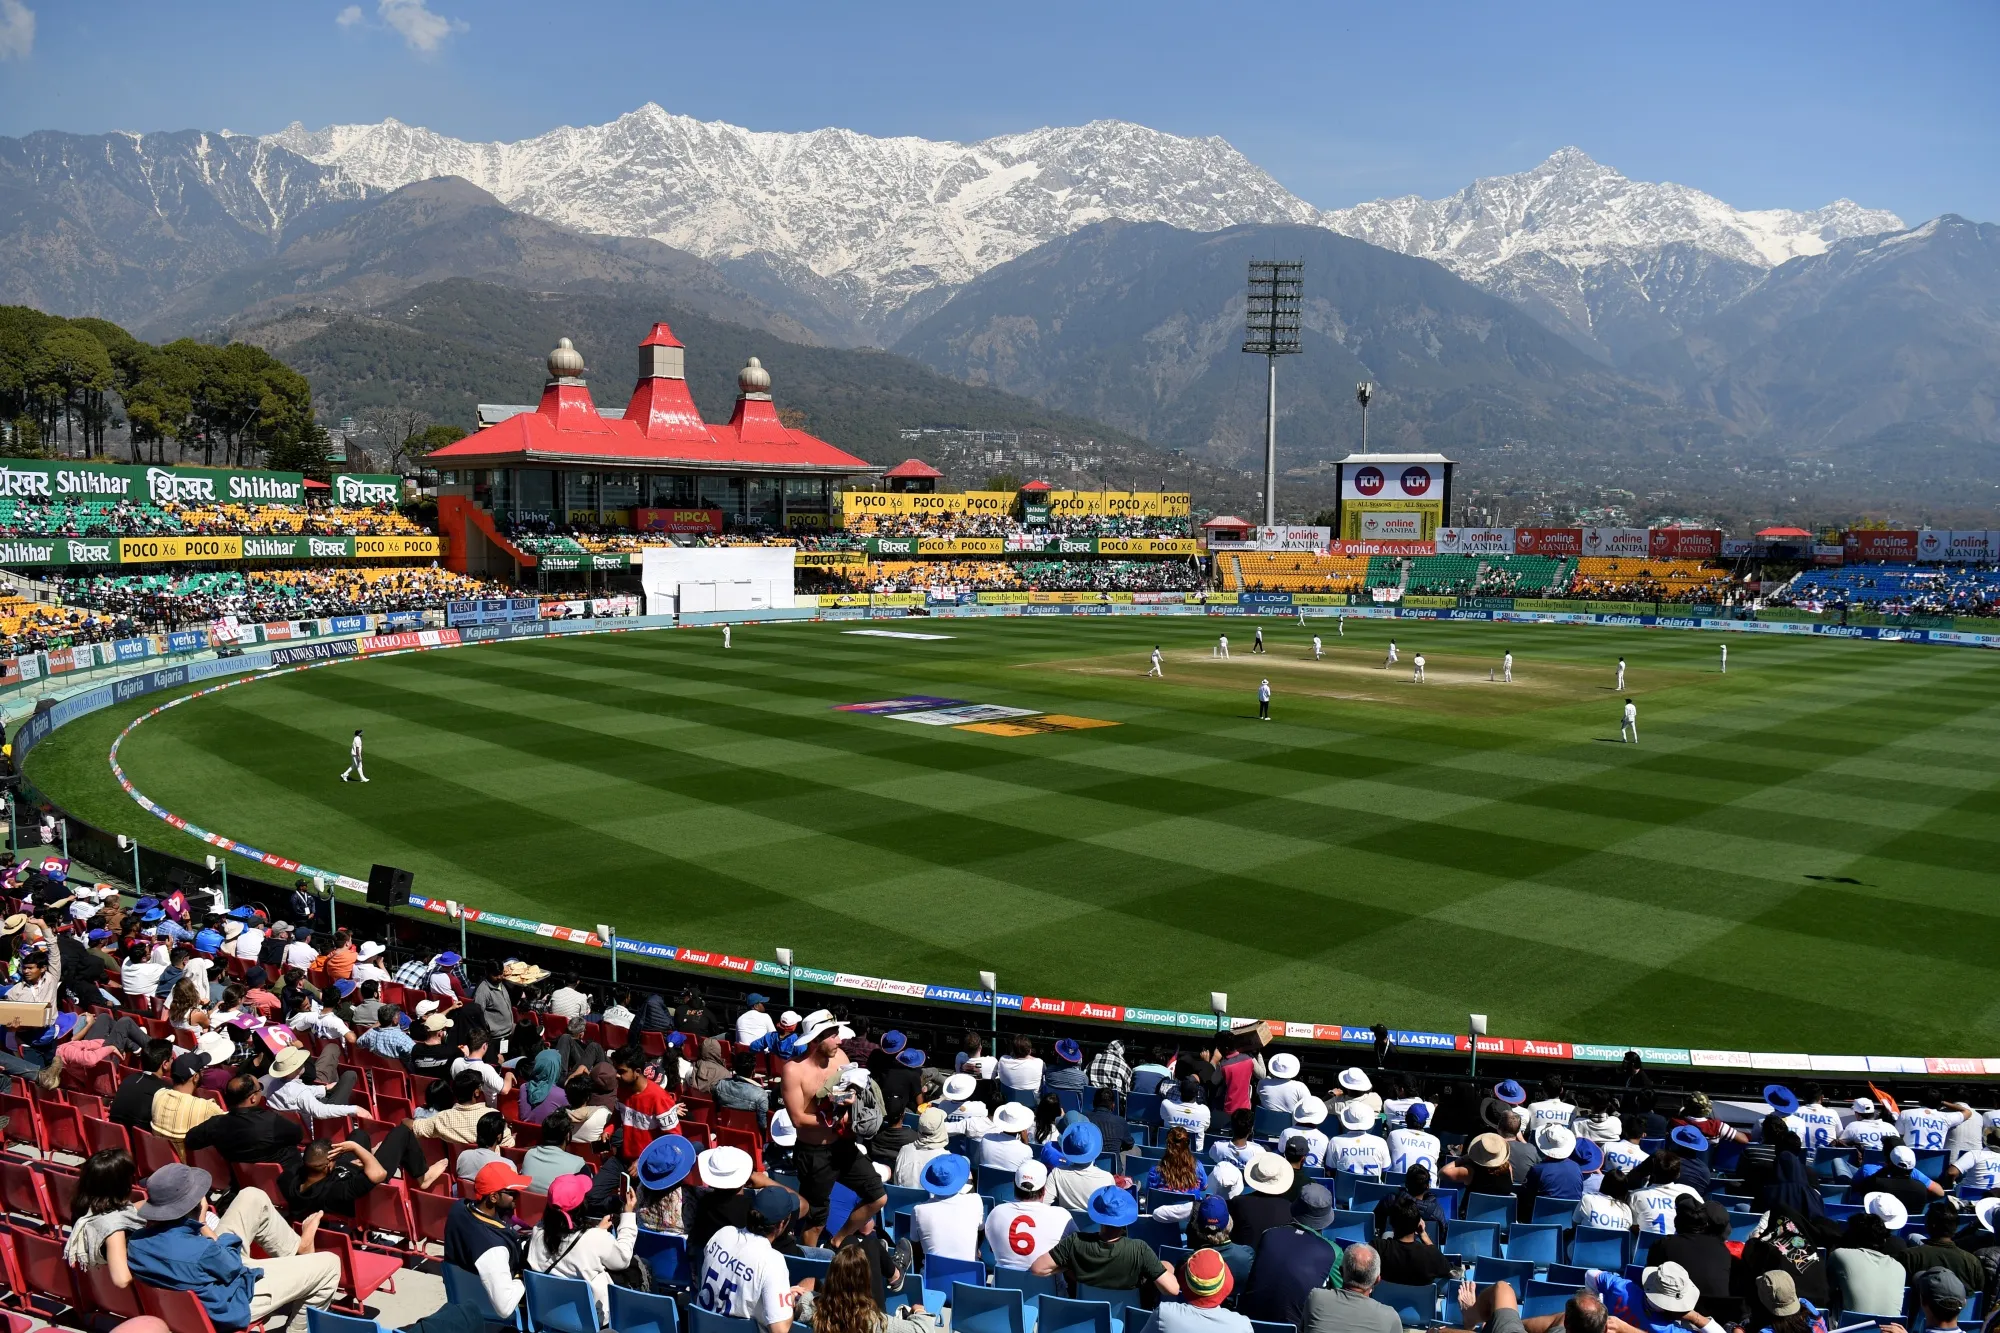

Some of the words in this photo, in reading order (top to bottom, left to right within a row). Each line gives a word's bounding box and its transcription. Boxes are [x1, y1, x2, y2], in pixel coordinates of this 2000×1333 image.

[56, 470, 131, 494] Shikhar
[146, 467, 216, 501] शिखर
[229, 476, 300, 499] Shikhar
[336, 475, 399, 503] शिखर
[855, 496, 886, 507] POCO
[890, 497, 903, 507] X6
[914, 497, 944, 508] POCO
[949, 498, 961, 508] X6
[967, 498, 998, 509] POCO
[1053, 499, 1084, 509] POCO
[1109, 499, 1140, 509] POCO
[1163, 496, 1189, 504] POCO
[673, 511, 710, 523] HPCA
[789, 515, 818, 526] POCO
[668, 523, 704, 531] Welcomes
[705, 523, 716, 531] You
[1385, 519, 1414, 528] online
[1289, 530, 1319, 540] online
[1471, 532, 1503, 541] online
[1545, 533, 1575, 543] online
[1612, 534, 1643, 543] online
[1680, 535, 1711, 545] online
[244, 539, 295, 556] Shikhar
[308, 537, 346, 556] शिखर
[356, 541, 385, 553] POCO
[388, 541, 400, 552] X6
[404, 541, 432, 552] POCO
[878, 539, 911, 553] शिखर
[919, 540, 944, 550] POCO
[961, 540, 986, 550] POCO
[990, 541, 1000, 550] X6
[1101, 541, 1128, 551] POCO
[1132, 542, 1143, 550] X6
[1150, 542, 1178, 551] POCO
[1182, 542, 1192, 550] X6
[1281, 541, 1326, 549] MANIPAL
[1346, 541, 1380, 554] online
[1382, 545, 1434, 554] MANIPAL
[1463, 543, 1511, 551] MANIPAL
[1538, 543, 1581, 551] MANIPAL
[1605, 544, 1649, 552] MANIPAL
[1873, 537, 1909, 548] online
[1953, 536, 1989, 549] online
[68, 540, 111, 563] शिखर
[123, 543, 158, 557] POCO
[162, 544, 176, 556] X6
[185, 541, 219, 556] POCO
[223, 542, 237, 554] X6
[1672, 545, 1717, 553] MANIPAL
[1865, 548, 1916, 556] MANIPAL
[1944, 549, 1997, 558] MANIPAL
[804, 555, 835, 566] POCO
[875, 594, 908, 602] Incredible
[979, 593, 1010, 601] Incredible
[1293, 596, 1328, 604] Incredible
[1459, 597, 1482, 608] IHG
[454, 602, 473, 612] KENT
[514, 600, 532, 609] KENT
[1027, 606, 1060, 614] Kajaria
[1073, 606, 1106, 614] Kajaria
[1211, 605, 1244, 614] Kajaria
[1258, 606, 1292, 614] Kajaria
[870, 608, 901, 617] Kajaria
[1402, 608, 1437, 618] Kajaria
[1450, 610, 1487, 619] Kajaria
[336, 617, 361, 628] verka
[1602, 615, 1641, 624] Kajaria
[1655, 617, 1694, 628] Kajaria
[466, 626, 500, 639] Kajaria
[511, 623, 544, 634] Kajaria
[1821, 626, 1862, 636] Kajaria
[1878, 628, 1922, 639] Kajaria
[172, 634, 196, 647] verka
[364, 634, 400, 650] MARIO
[401, 634, 418, 644] AFC
[441, 630, 458, 640] AFC
[119, 641, 142, 654] verka
[276, 650, 290, 664] RAJ
[291, 646, 314, 660] NIWAS
[317, 644, 330, 657] RAJ
[332, 640, 358, 654] NIWAS
[118, 679, 144, 699] Kajaria
[154, 668, 183, 688] Kajaria
[265, 854, 278, 865] Amul
[280, 859, 295, 871] Amul
[485, 914, 508, 926] Simpolo
[515, 920, 538, 932] Simpolo
[612, 940, 638, 951] STRAL
[646, 945, 675, 957] ASTRAL
[681, 949, 710, 964] Amul
[719, 956, 748, 971] Amul
[804, 970, 835, 982] Simpolo
[936, 989, 972, 1001] ASTRAL
[984, 995, 1020, 1007] ATRAL
[1030, 996, 1065, 1012] Amul
[1080, 1002, 1117, 1018] Amul
[1137, 1010, 1176, 1024] Simpolo
[1190, 1016, 1230, 1029] Simpoo
[1410, 1034, 1454, 1046] ASTRAL
[1522, 1040, 1564, 1056] Amul
[1646, 1049, 1690, 1062] Simpolo
[1936, 1058, 1976, 1072] Amul
[1173, 1117, 1201, 1127] VIRAT
[1910, 1116, 1946, 1131] VIRAT
[1400, 1138, 1432, 1150] VIRAT
[1910, 1130, 1943, 1150] 18
[1342, 1147, 1376, 1156] ROHIT
[1008, 1214, 1035, 1256] 6
[709, 1241, 754, 1282] STOKES
[699, 1267, 738, 1316] 55
